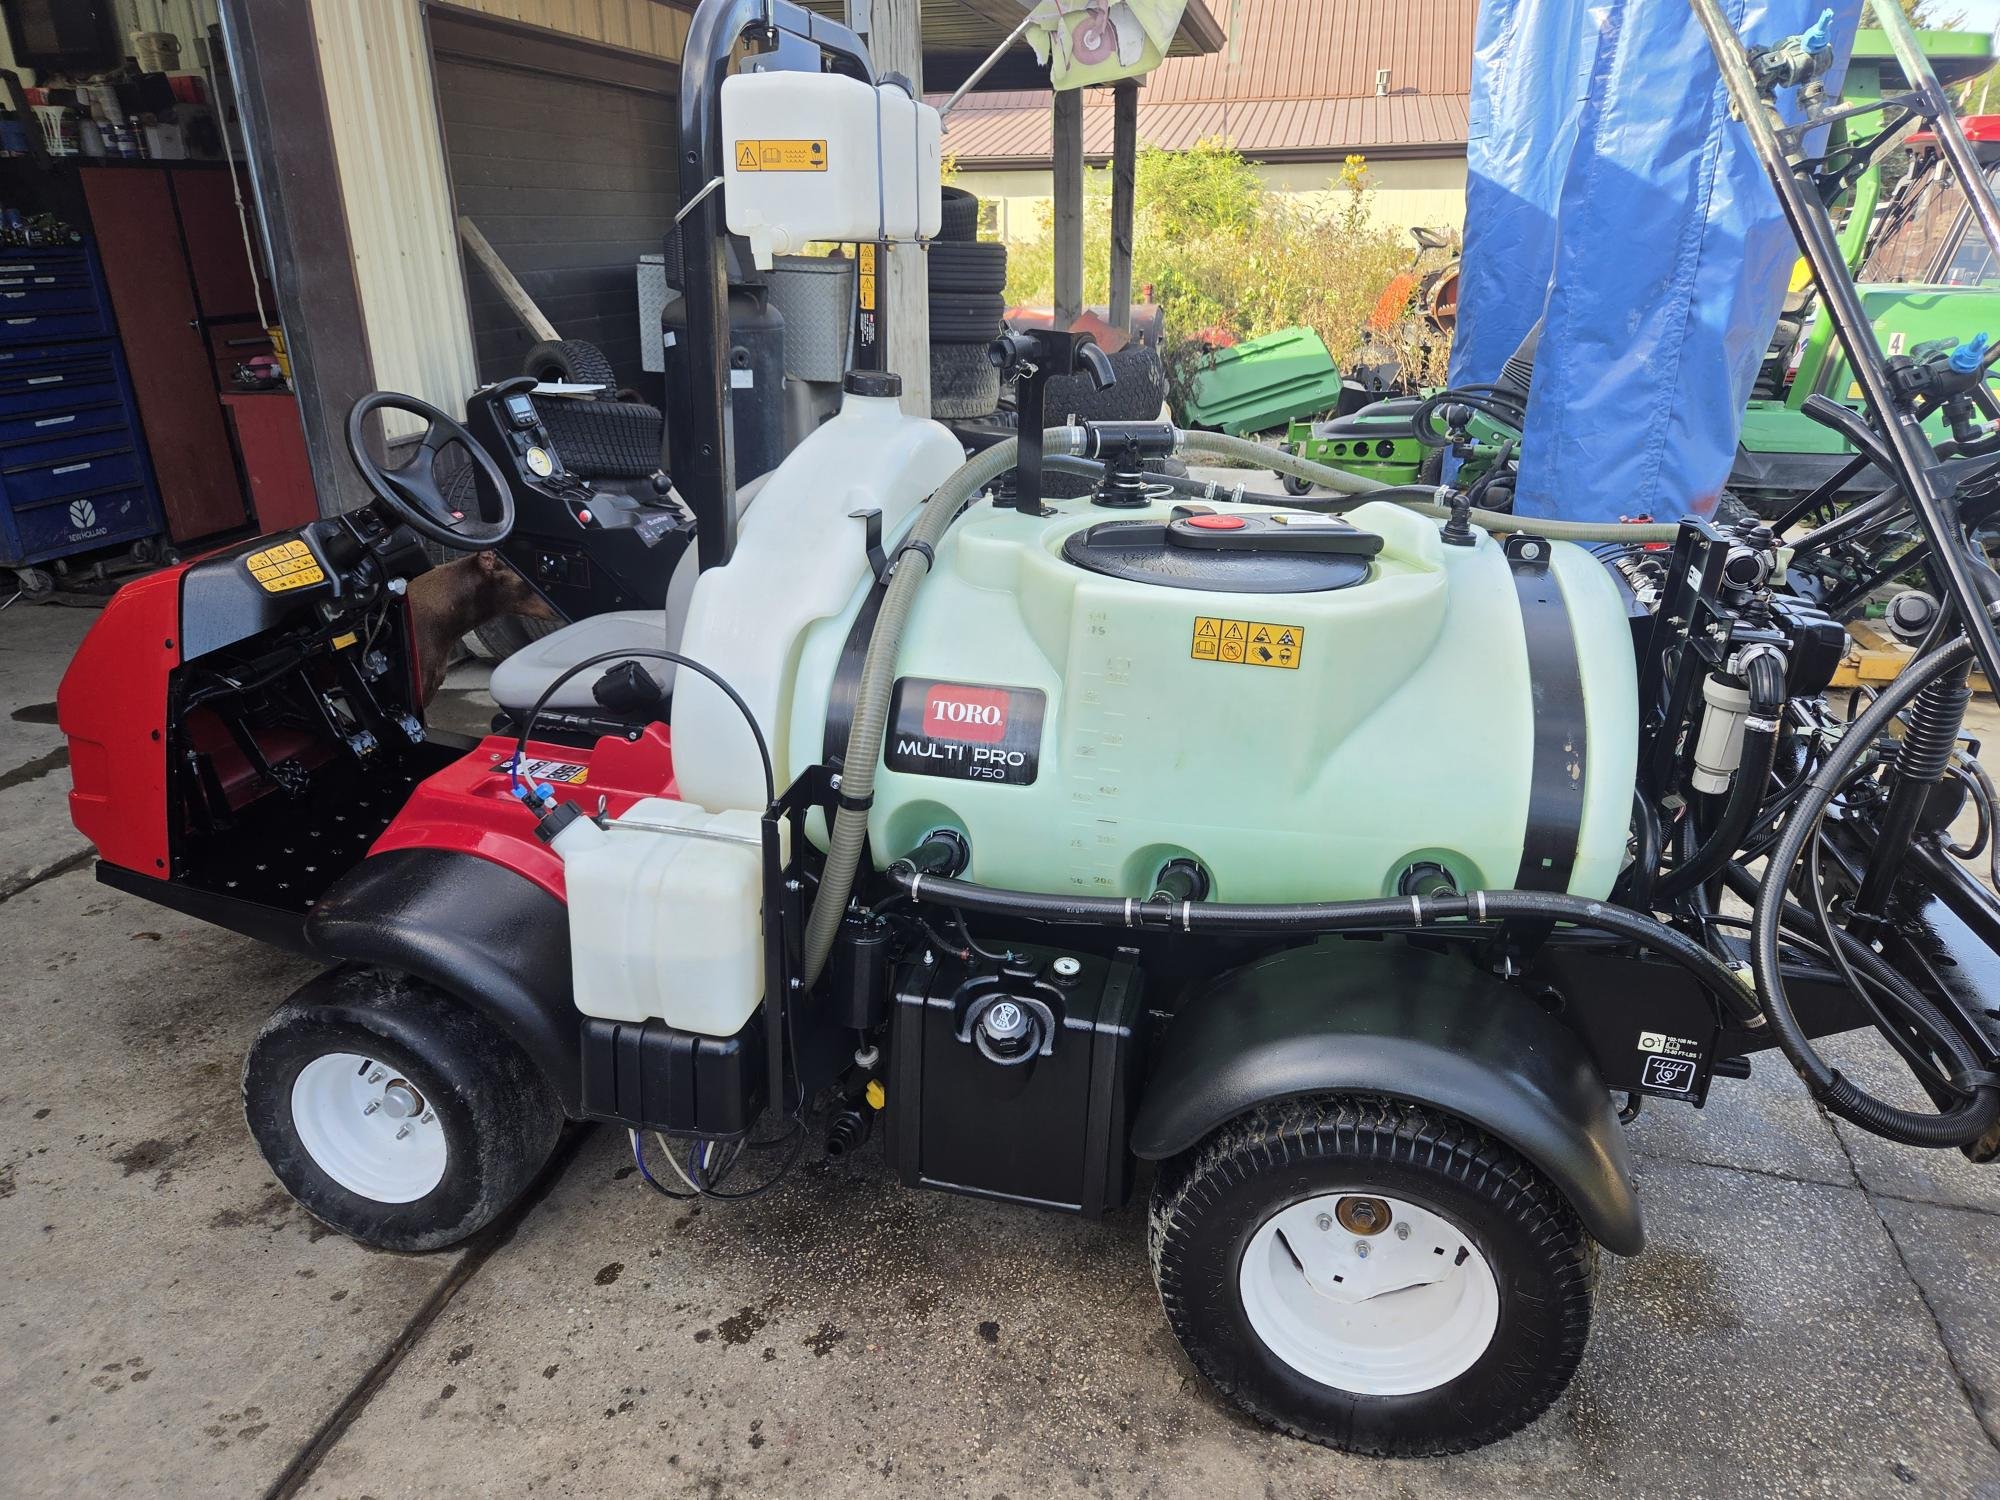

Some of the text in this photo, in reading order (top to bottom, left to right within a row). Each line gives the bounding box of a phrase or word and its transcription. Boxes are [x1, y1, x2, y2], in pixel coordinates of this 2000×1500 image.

[1890, 334, 1901, 354] 4
[932, 701, 1001, 725] TORO
[897, 740, 1025, 766] MULTI PRO
[969, 766, 1005, 779] 1750
